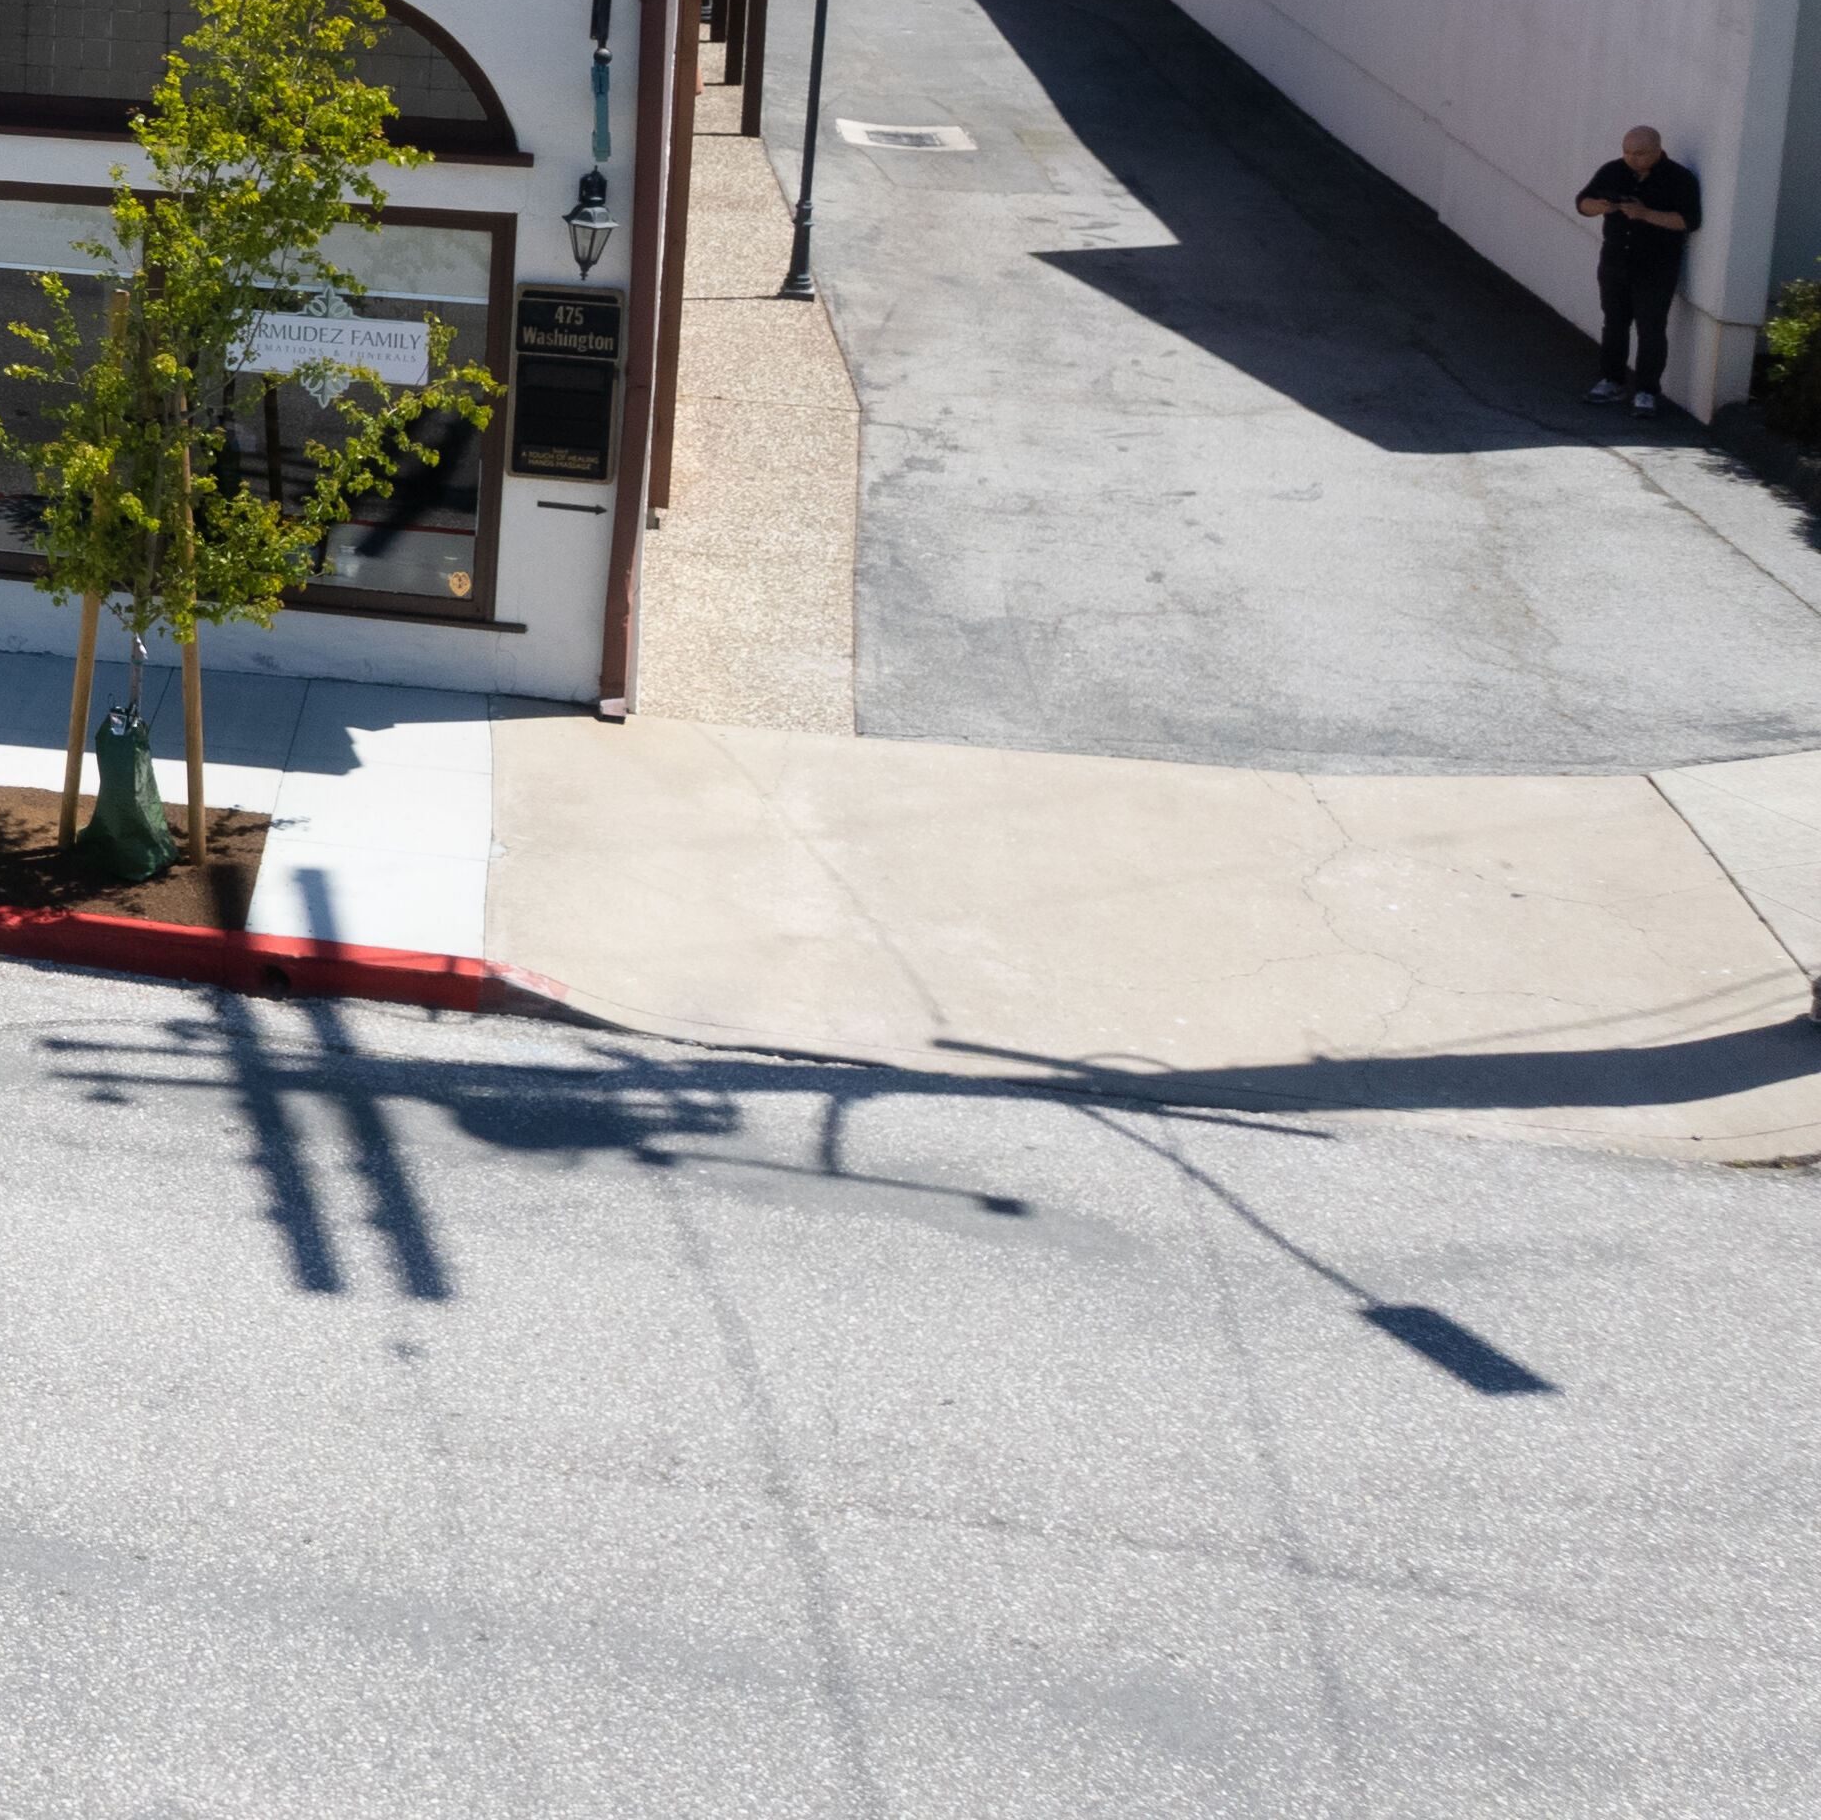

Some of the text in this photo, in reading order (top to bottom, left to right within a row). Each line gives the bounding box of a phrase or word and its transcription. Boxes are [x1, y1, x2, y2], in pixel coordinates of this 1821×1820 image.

[555, 305, 584, 326] 475
[350, 330, 422, 351] FAMILY
[523, 326, 614, 353] Washington
[349, 350, 417, 363] FUNERALS
